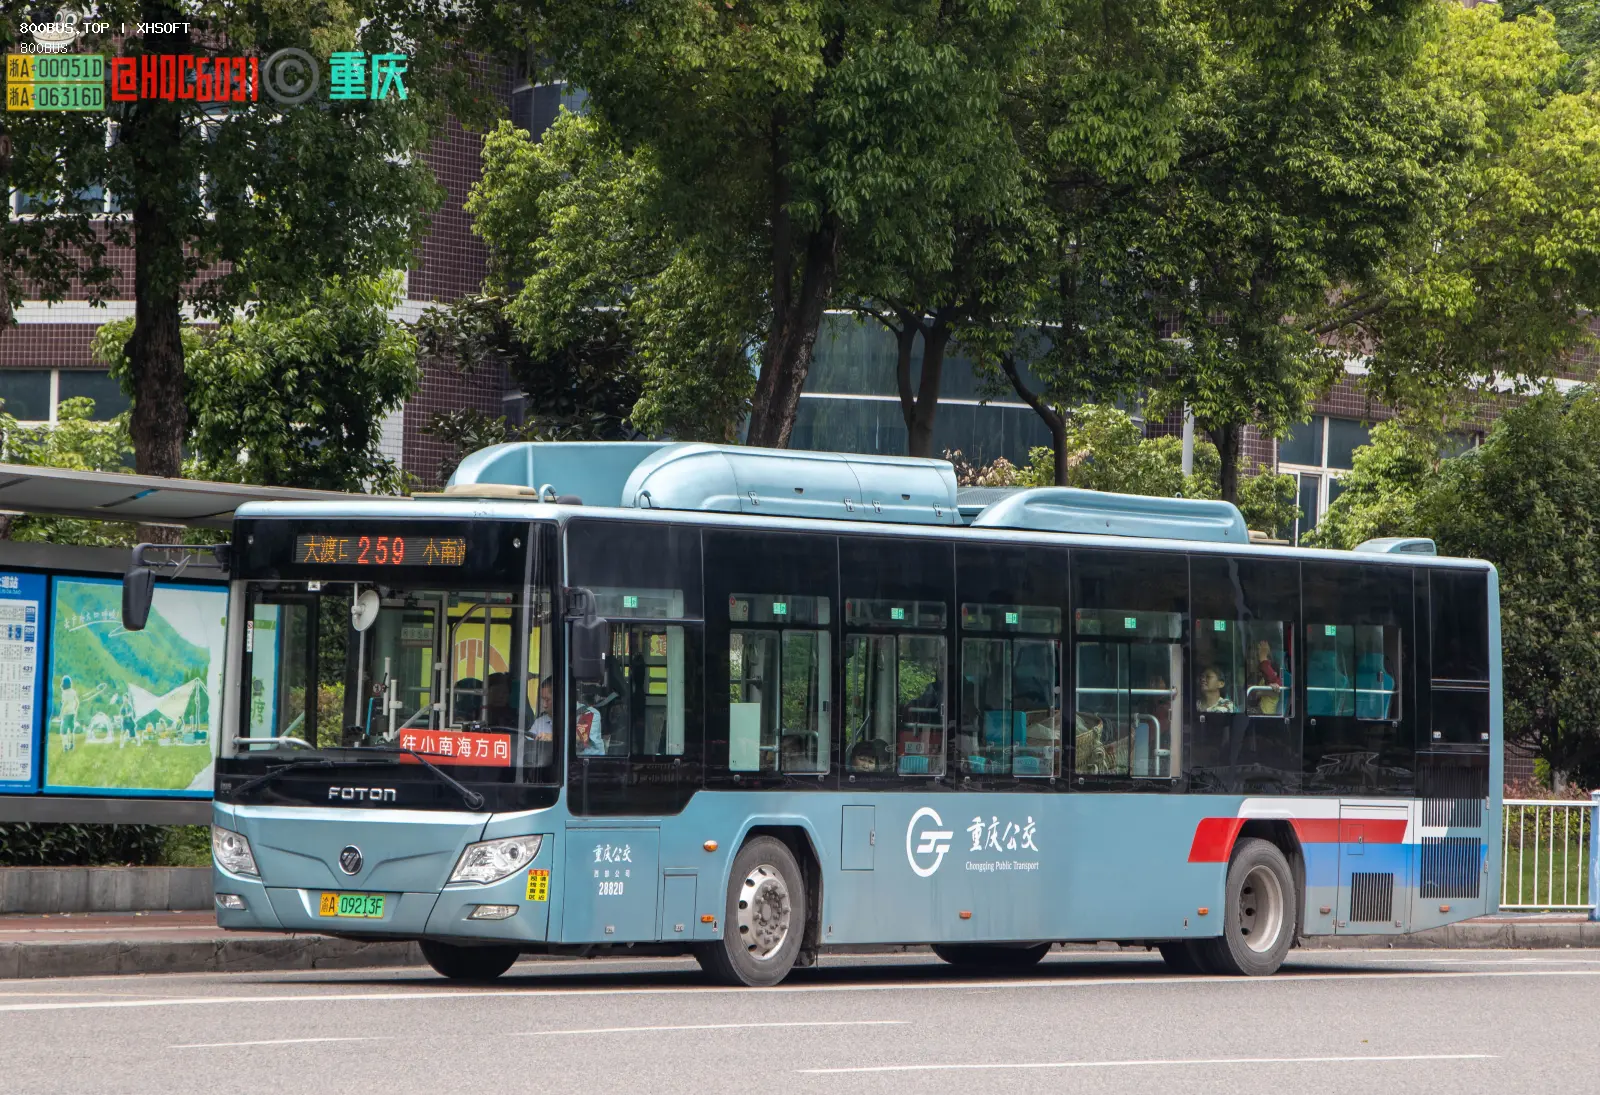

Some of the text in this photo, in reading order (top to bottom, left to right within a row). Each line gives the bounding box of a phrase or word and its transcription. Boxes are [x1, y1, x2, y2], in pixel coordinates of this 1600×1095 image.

[357, 536, 404, 565] 259
[402, 734, 508, 760] 往小南海方向
[328, 786, 397, 802] FOTON
[966, 815, 1039, 853] 重庆公交
[592, 844, 633, 863] 重庆公交
[965, 860, 1039, 873] Chongqing Public Transport
[598, 881, 624, 896] 28820
